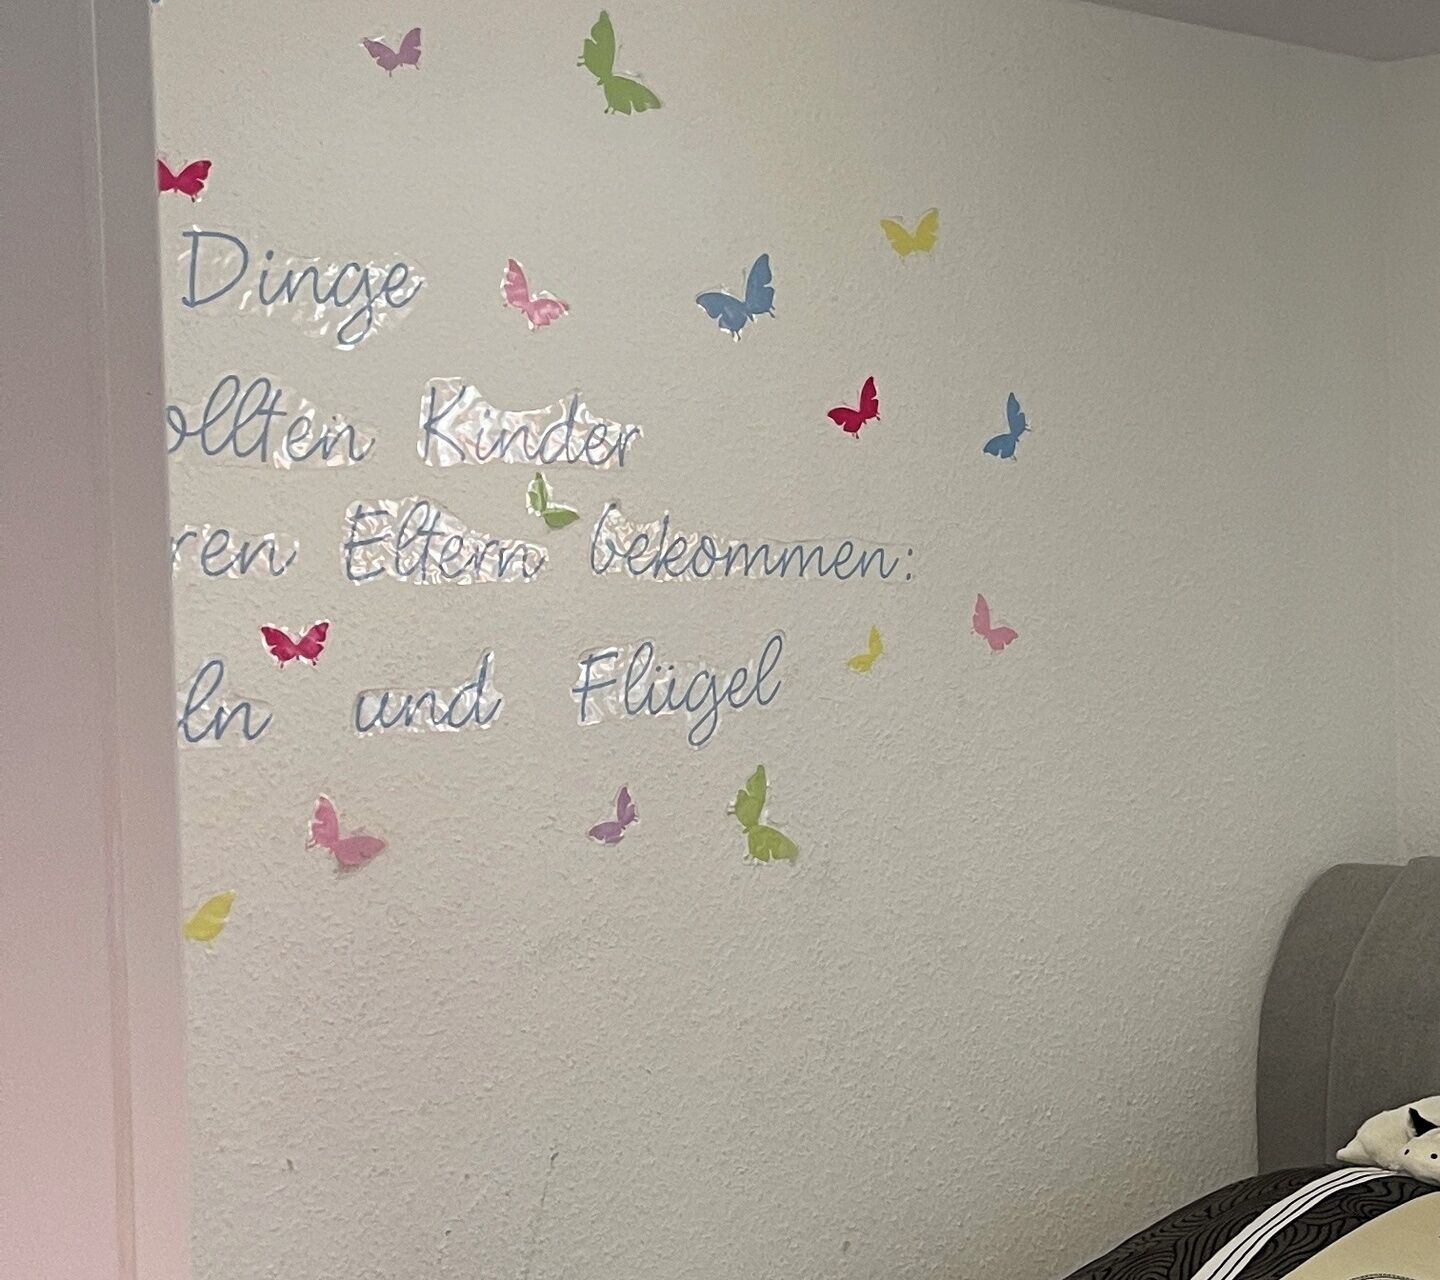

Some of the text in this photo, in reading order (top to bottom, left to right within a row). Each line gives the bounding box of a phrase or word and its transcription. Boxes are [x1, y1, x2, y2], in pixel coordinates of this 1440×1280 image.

[182, 230, 424, 345] Dinge
[422, 384, 642, 467] Kinder
[343, 500, 547, 582] Eltern
[590, 502, 914, 581] bekommen:
[354, 649, 502, 733] und
[571, 634, 784, 747] Flügel
